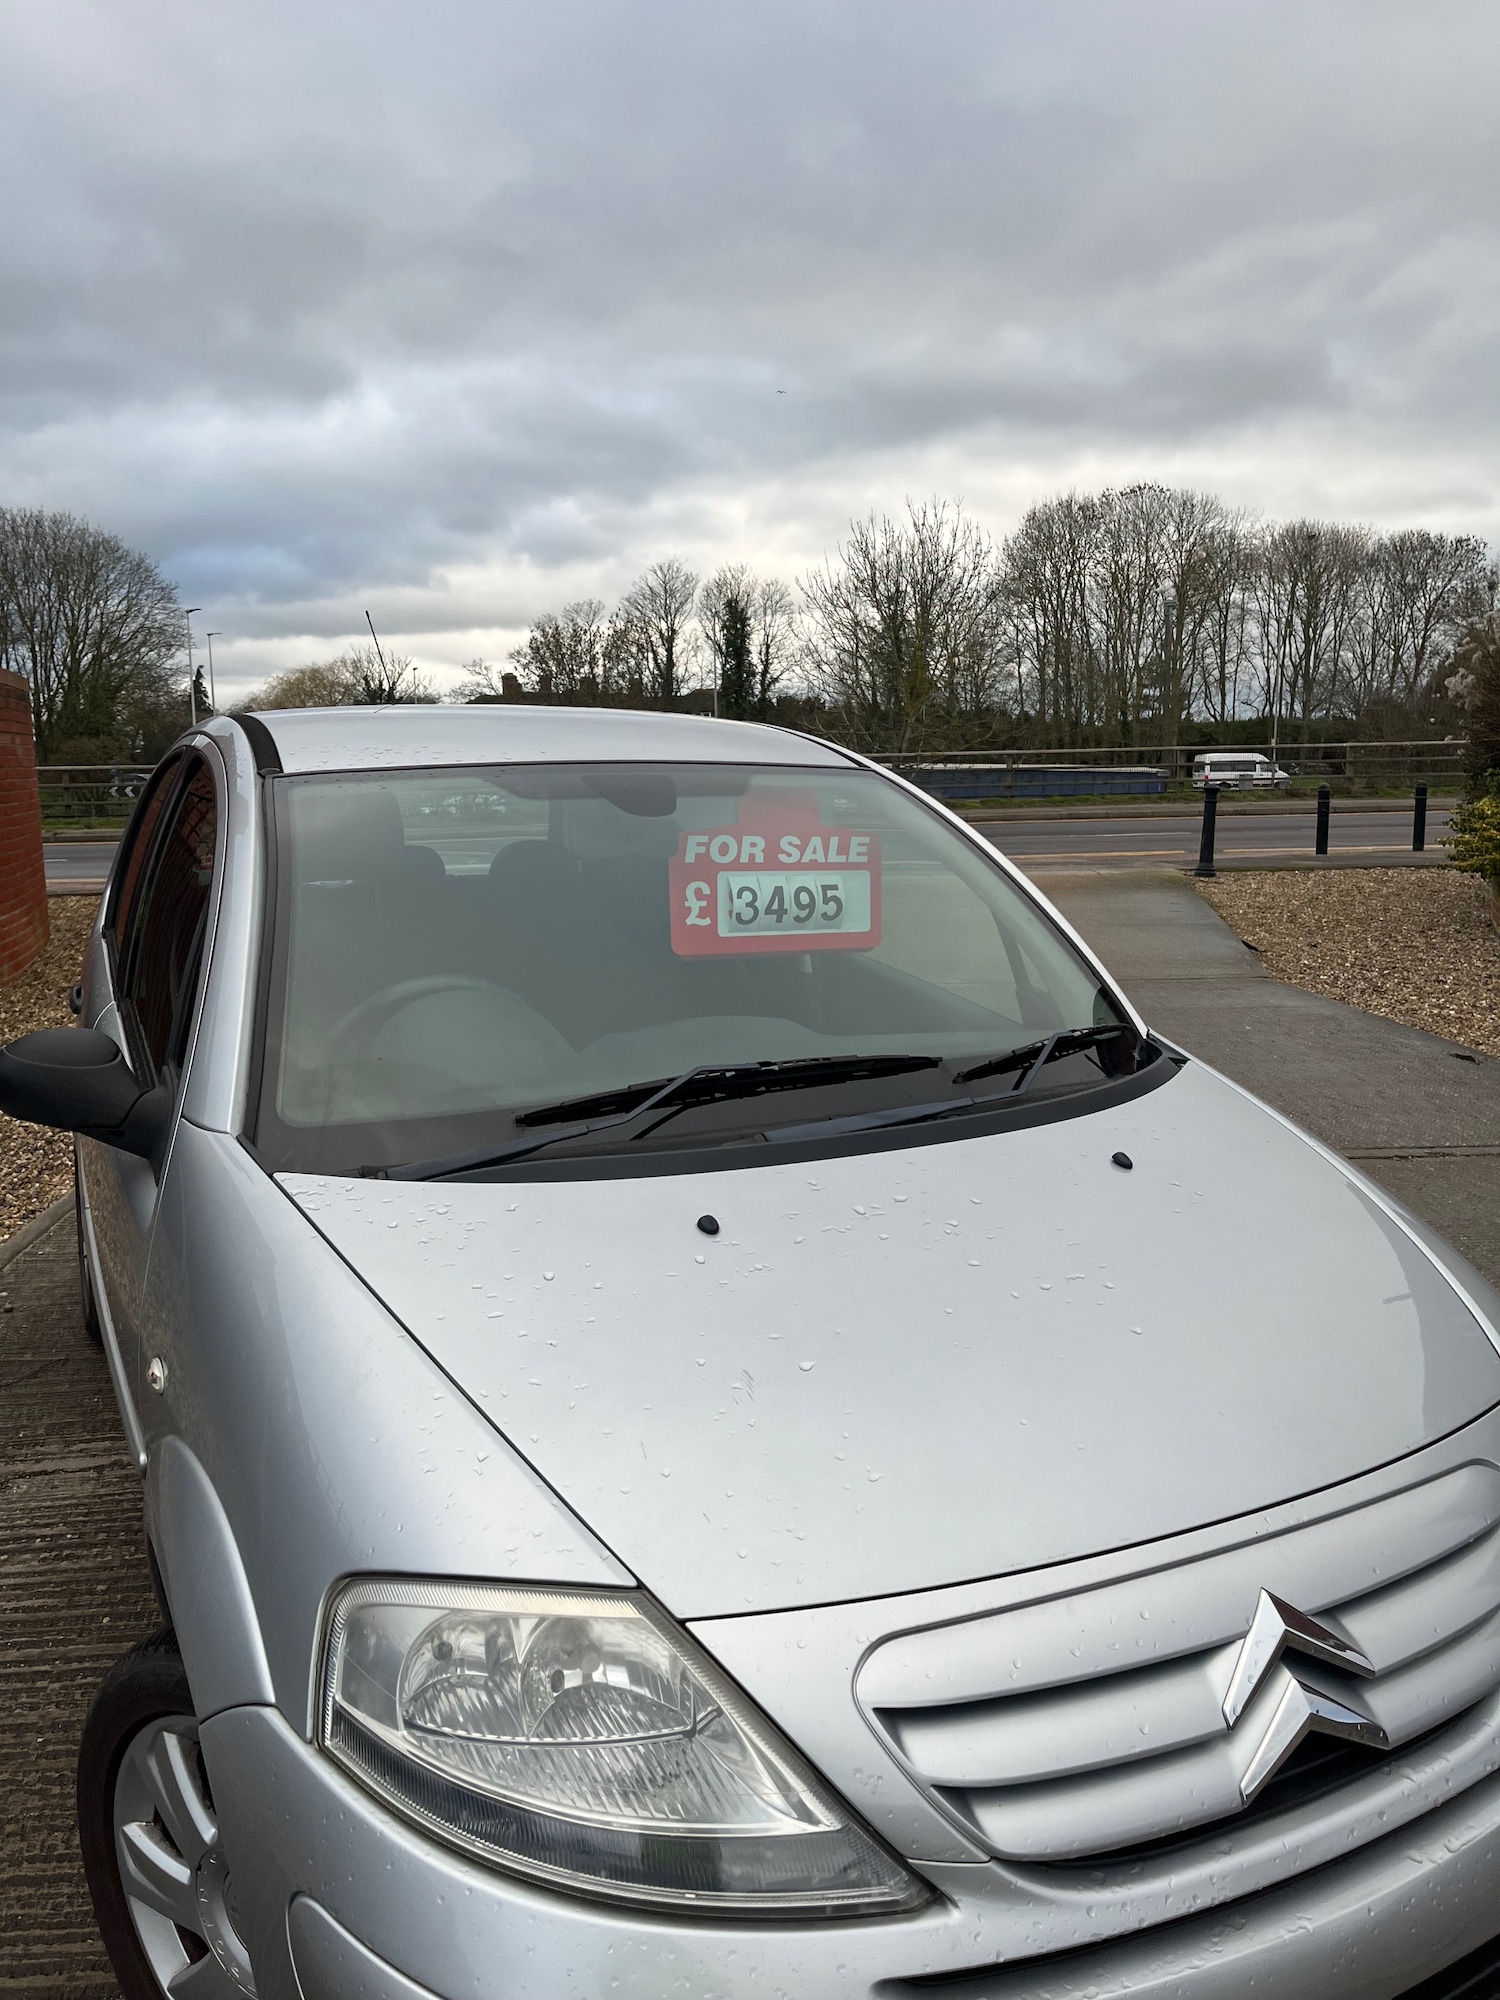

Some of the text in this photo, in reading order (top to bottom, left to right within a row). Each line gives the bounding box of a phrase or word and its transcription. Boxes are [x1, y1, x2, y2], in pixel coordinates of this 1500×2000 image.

[684, 835, 871, 864] FOR SALE
[734, 883, 844, 926] 3495
